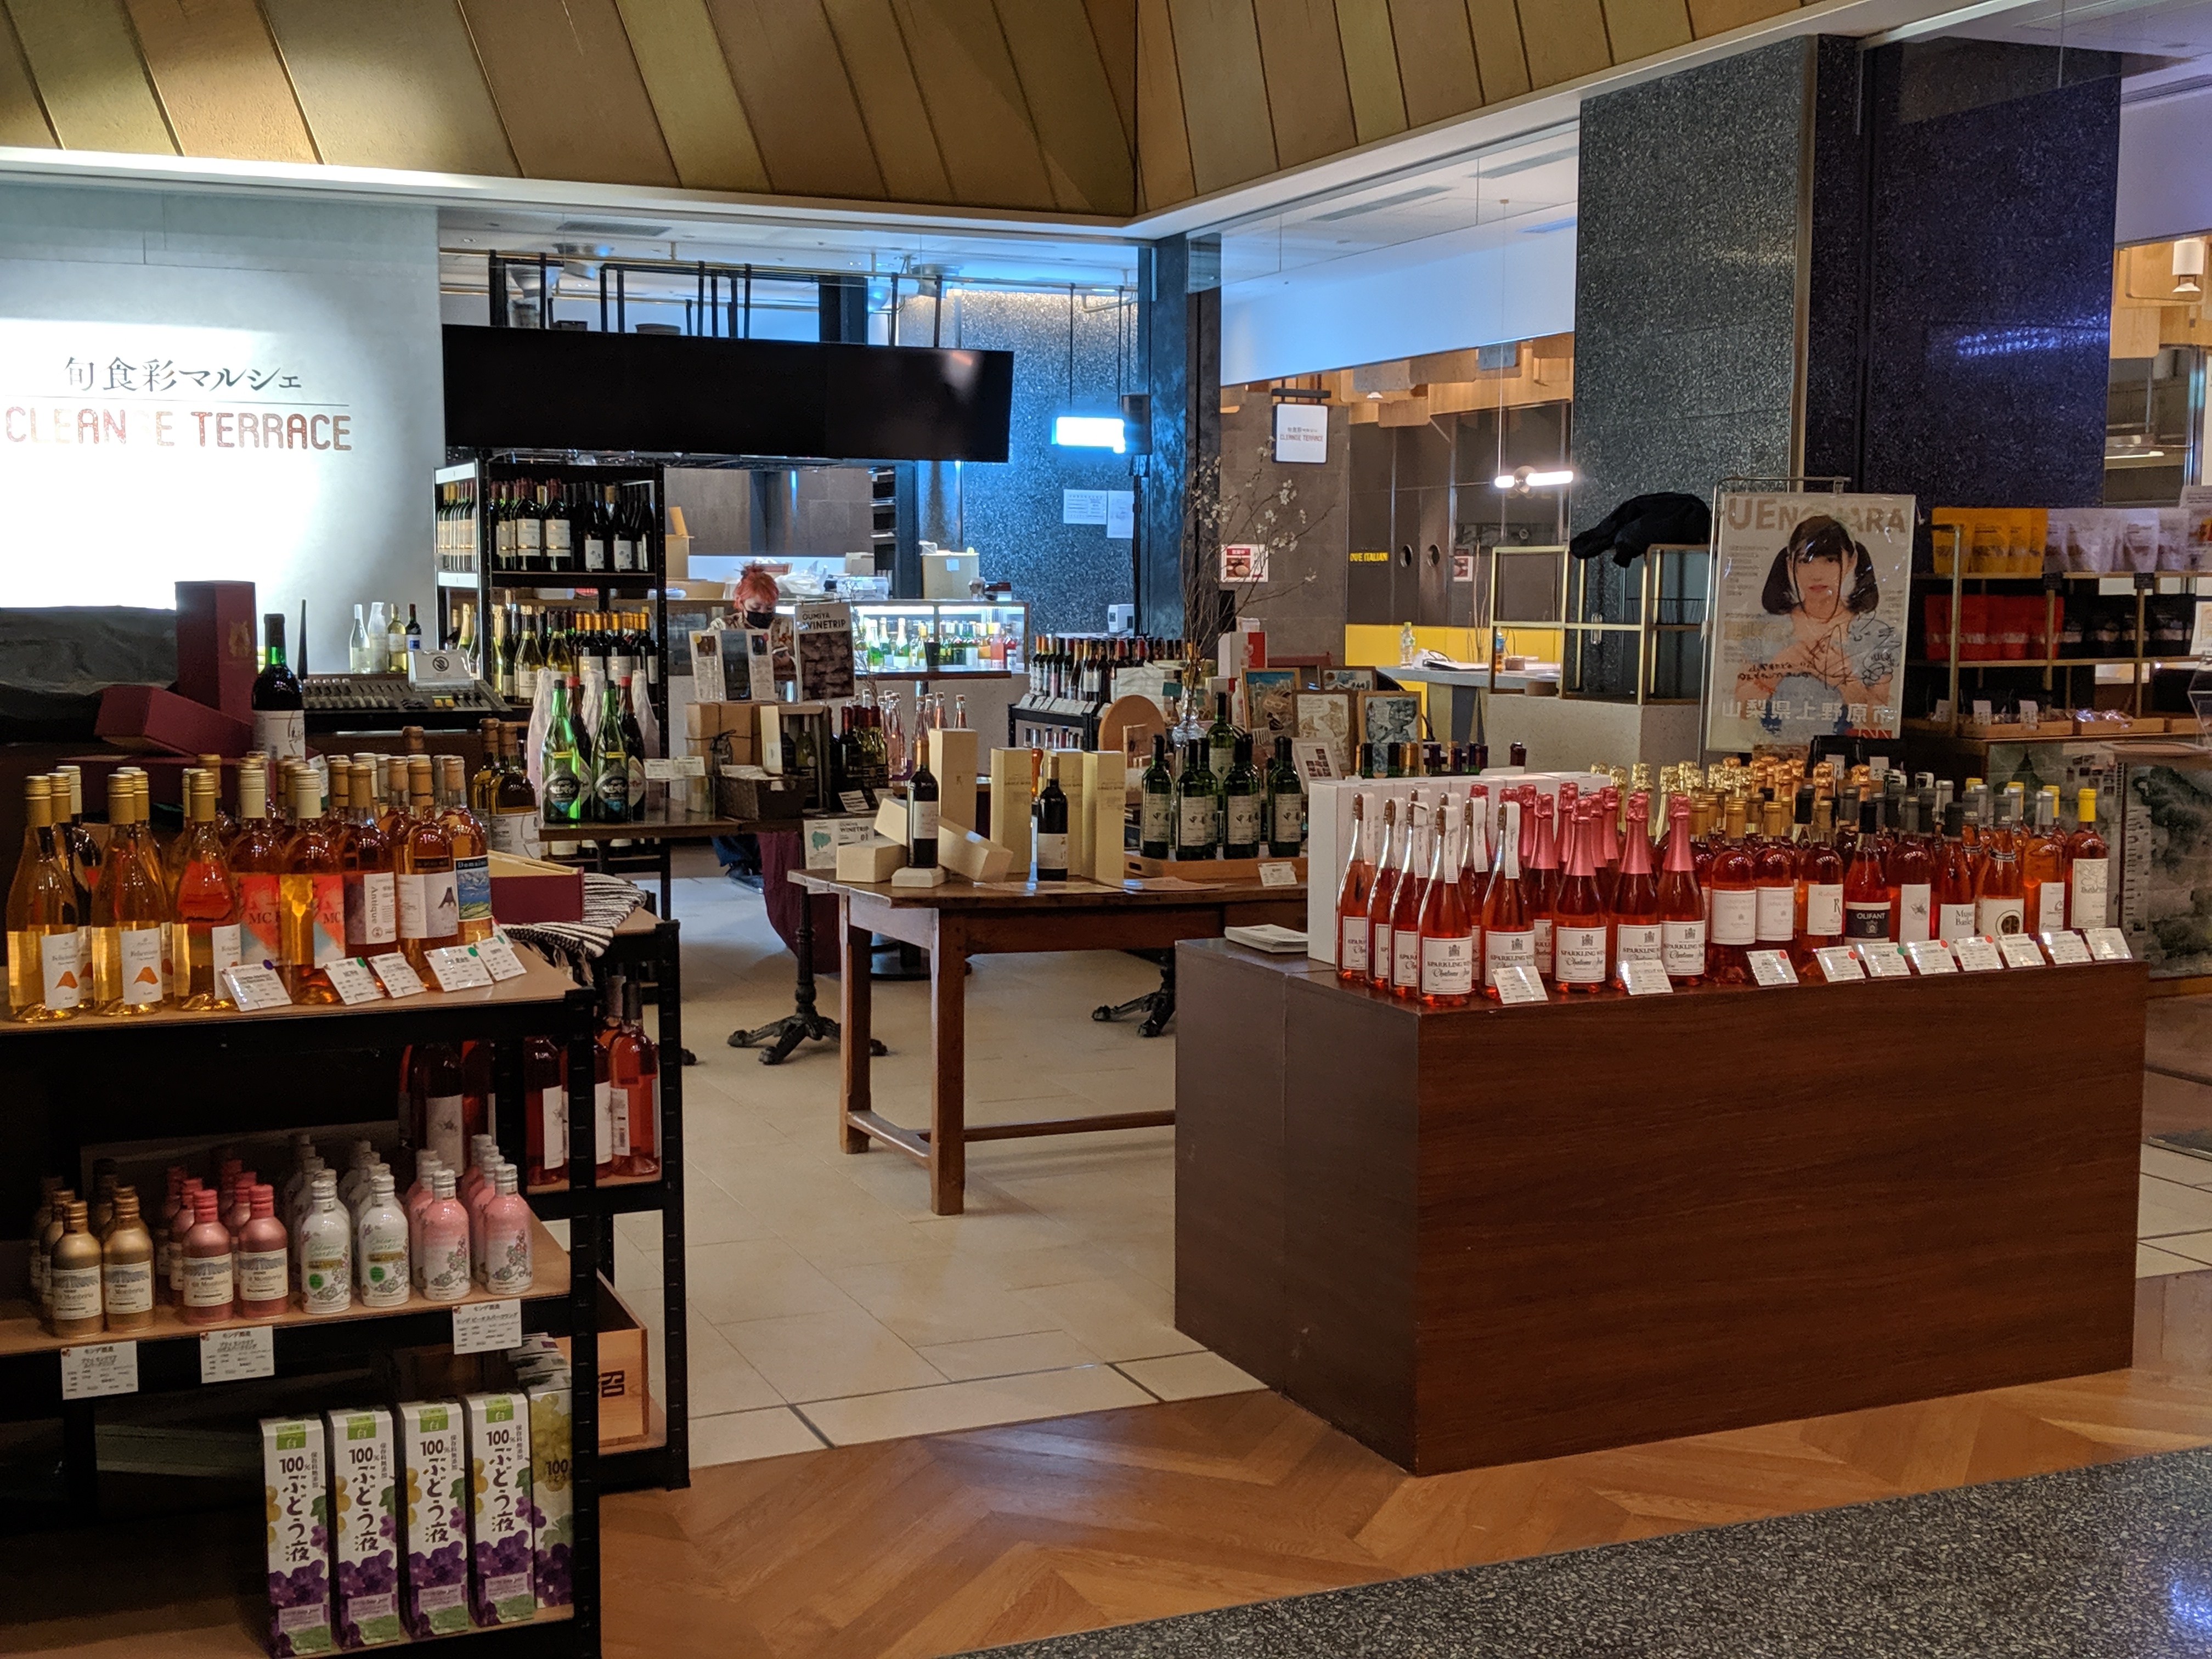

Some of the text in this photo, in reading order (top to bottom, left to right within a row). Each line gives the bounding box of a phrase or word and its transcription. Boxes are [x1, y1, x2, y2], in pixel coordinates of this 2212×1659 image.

[64, 355, 302, 393] 旬食彩マルシェ
[5, 406, 352, 450] CLEANE TERRACE
[1727, 497, 1906, 533] UENARA
[370, 886, 379, 924] Antique
[348, 1446, 380, 1464] 100%
[420, 1439, 450, 1457] 100%
[486, 1429, 516, 1446] 100%
[279, 1455, 311, 1474] 100%
[352, 1465, 379, 1552] ぶどう液
[422, 1458, 449, 1543] ぶどう液
[488, 1447, 515, 1532] ぶどう液
[282, 1475, 310, 1562] ぶどう液
